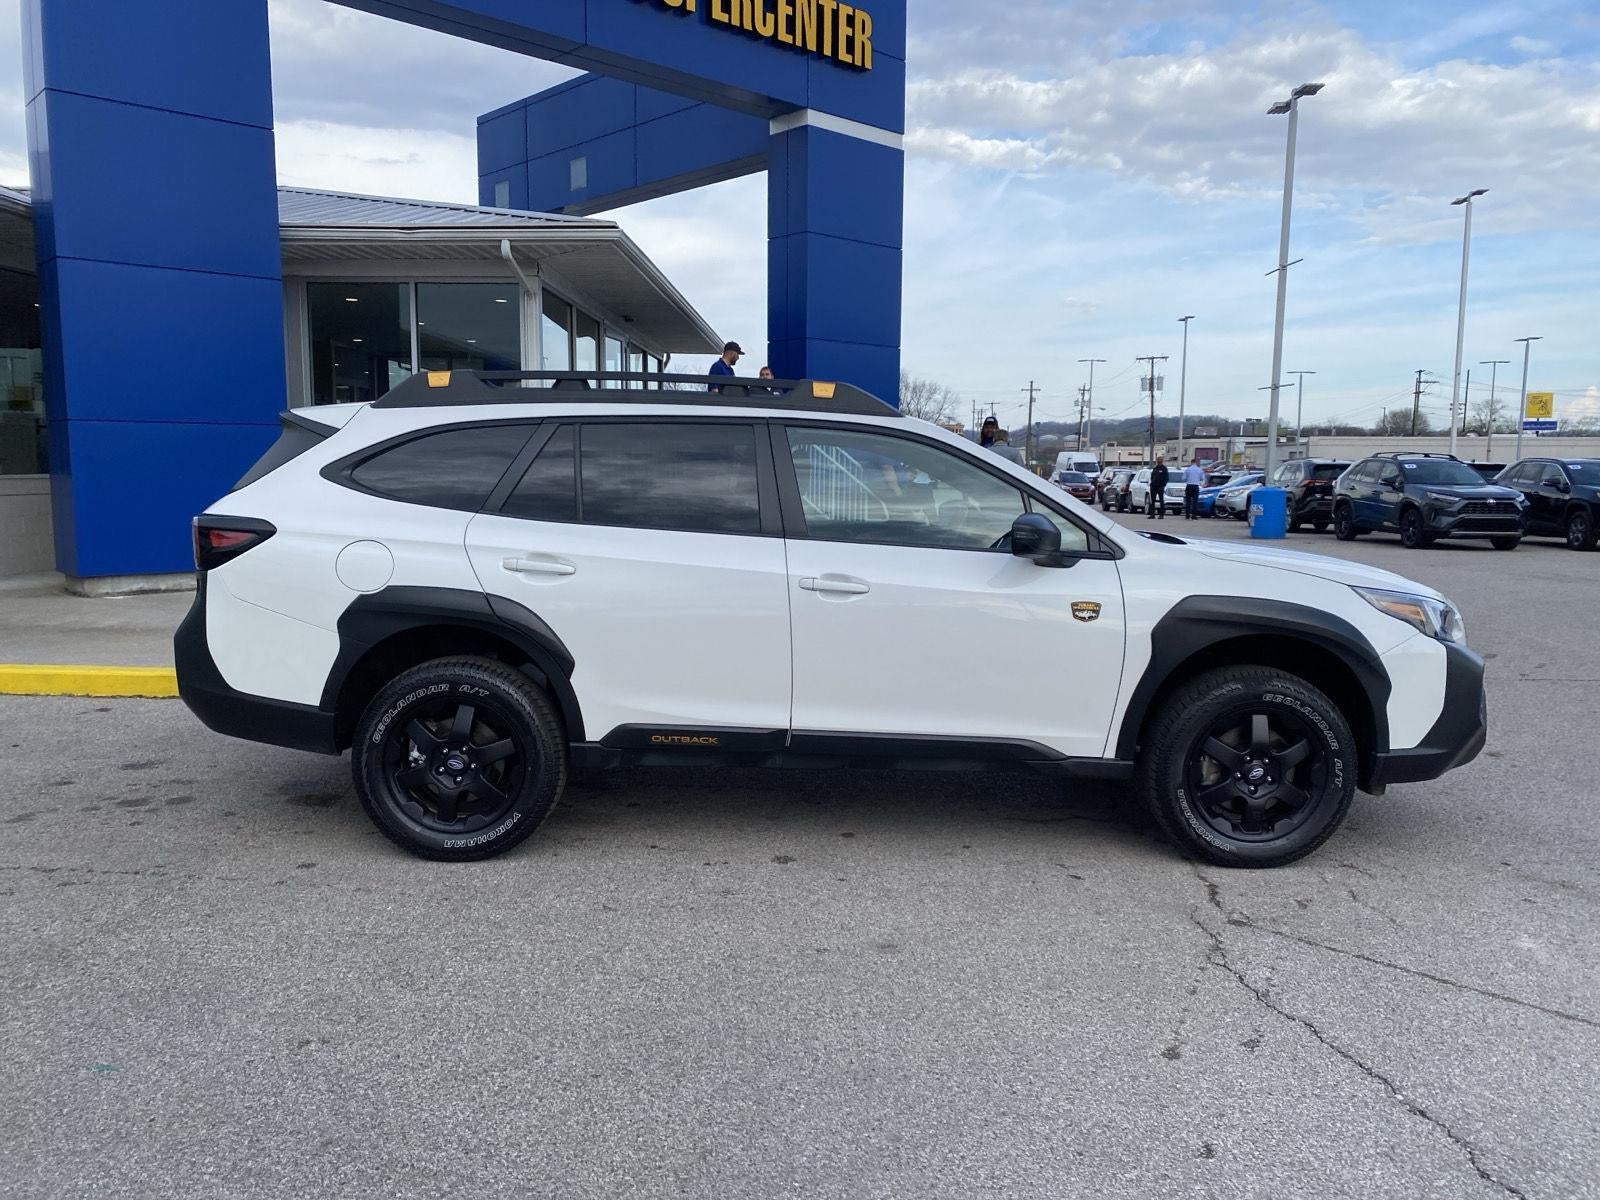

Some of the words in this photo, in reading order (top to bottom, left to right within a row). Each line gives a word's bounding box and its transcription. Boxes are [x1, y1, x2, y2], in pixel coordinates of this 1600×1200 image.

[372, 683, 450, 743] GEOLANDAR
[458, 684, 490, 697] A/T
[650, 735, 719, 744] OUTBACK
[1262, 693, 1340, 751] GEOLANDAR
[443, 811, 522, 848] YOKOHAMA
[1177, 788, 1230, 852] YOKOHAMA
